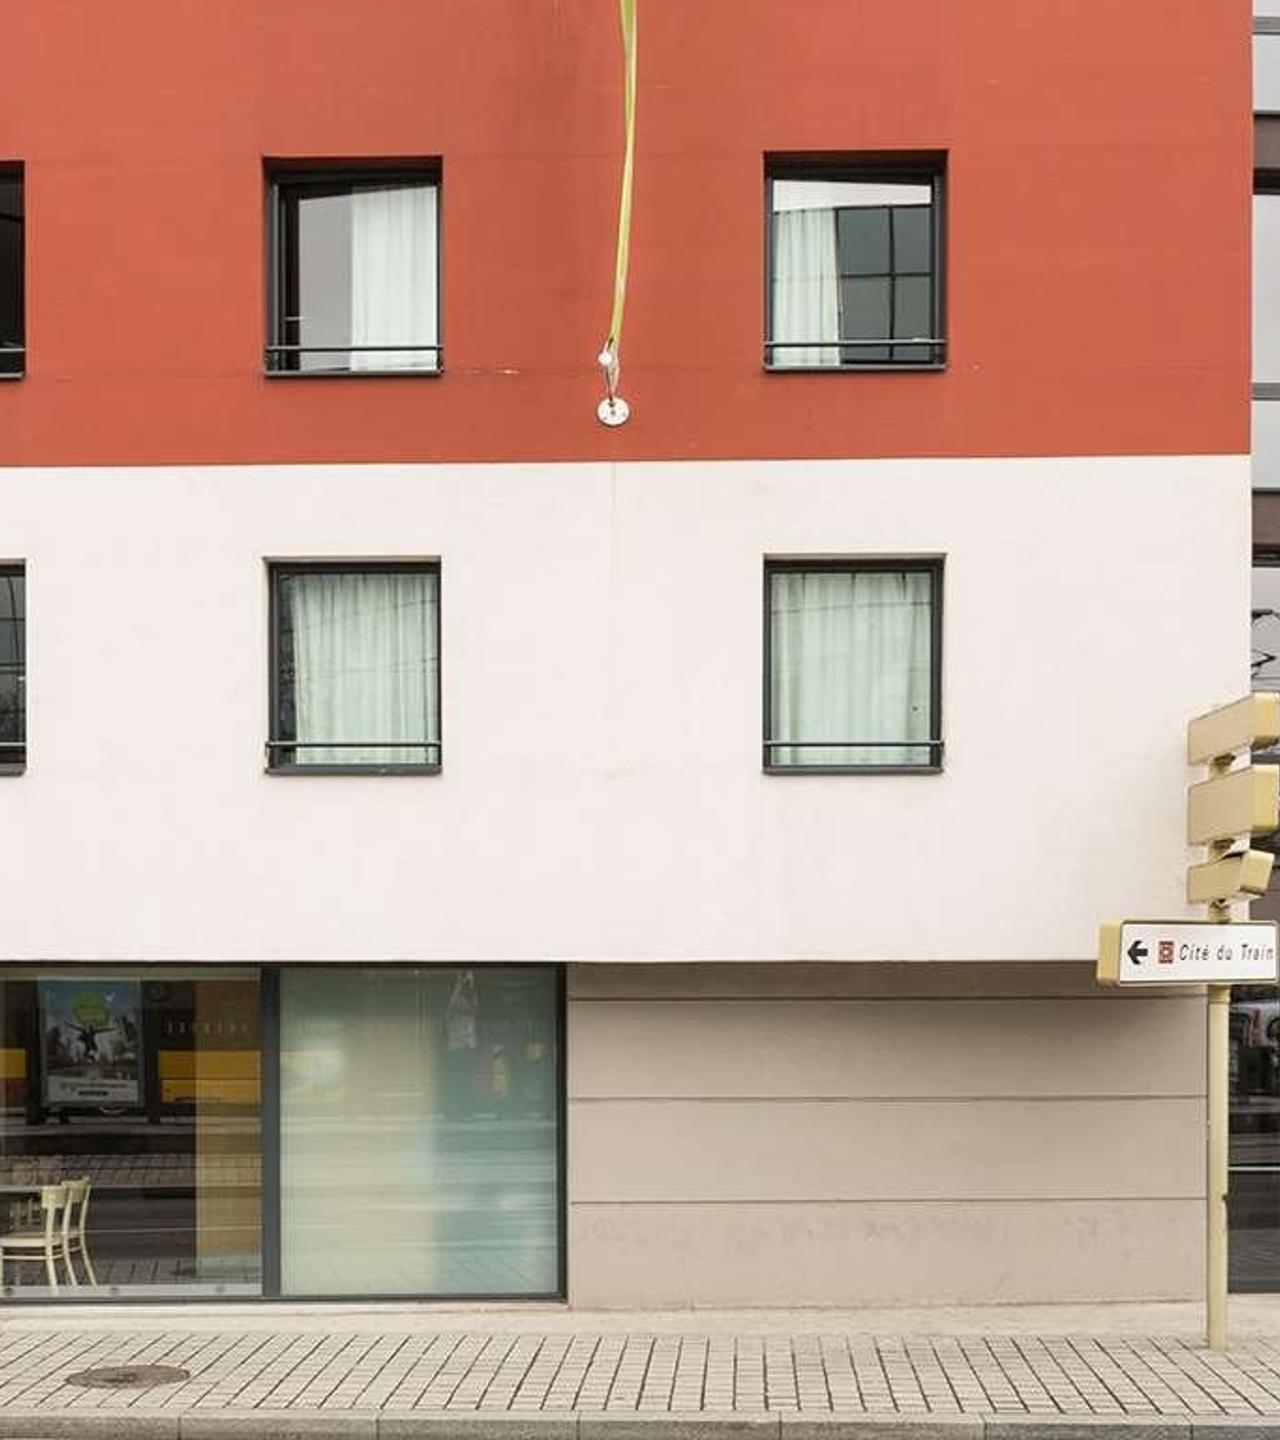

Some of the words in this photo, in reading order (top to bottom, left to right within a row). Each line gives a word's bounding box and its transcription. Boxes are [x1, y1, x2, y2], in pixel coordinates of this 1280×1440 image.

[1179, 944, 1209, 961] Cité
[1216, 946, 1233, 961] du
[1241, 944, 1273, 961] Train
